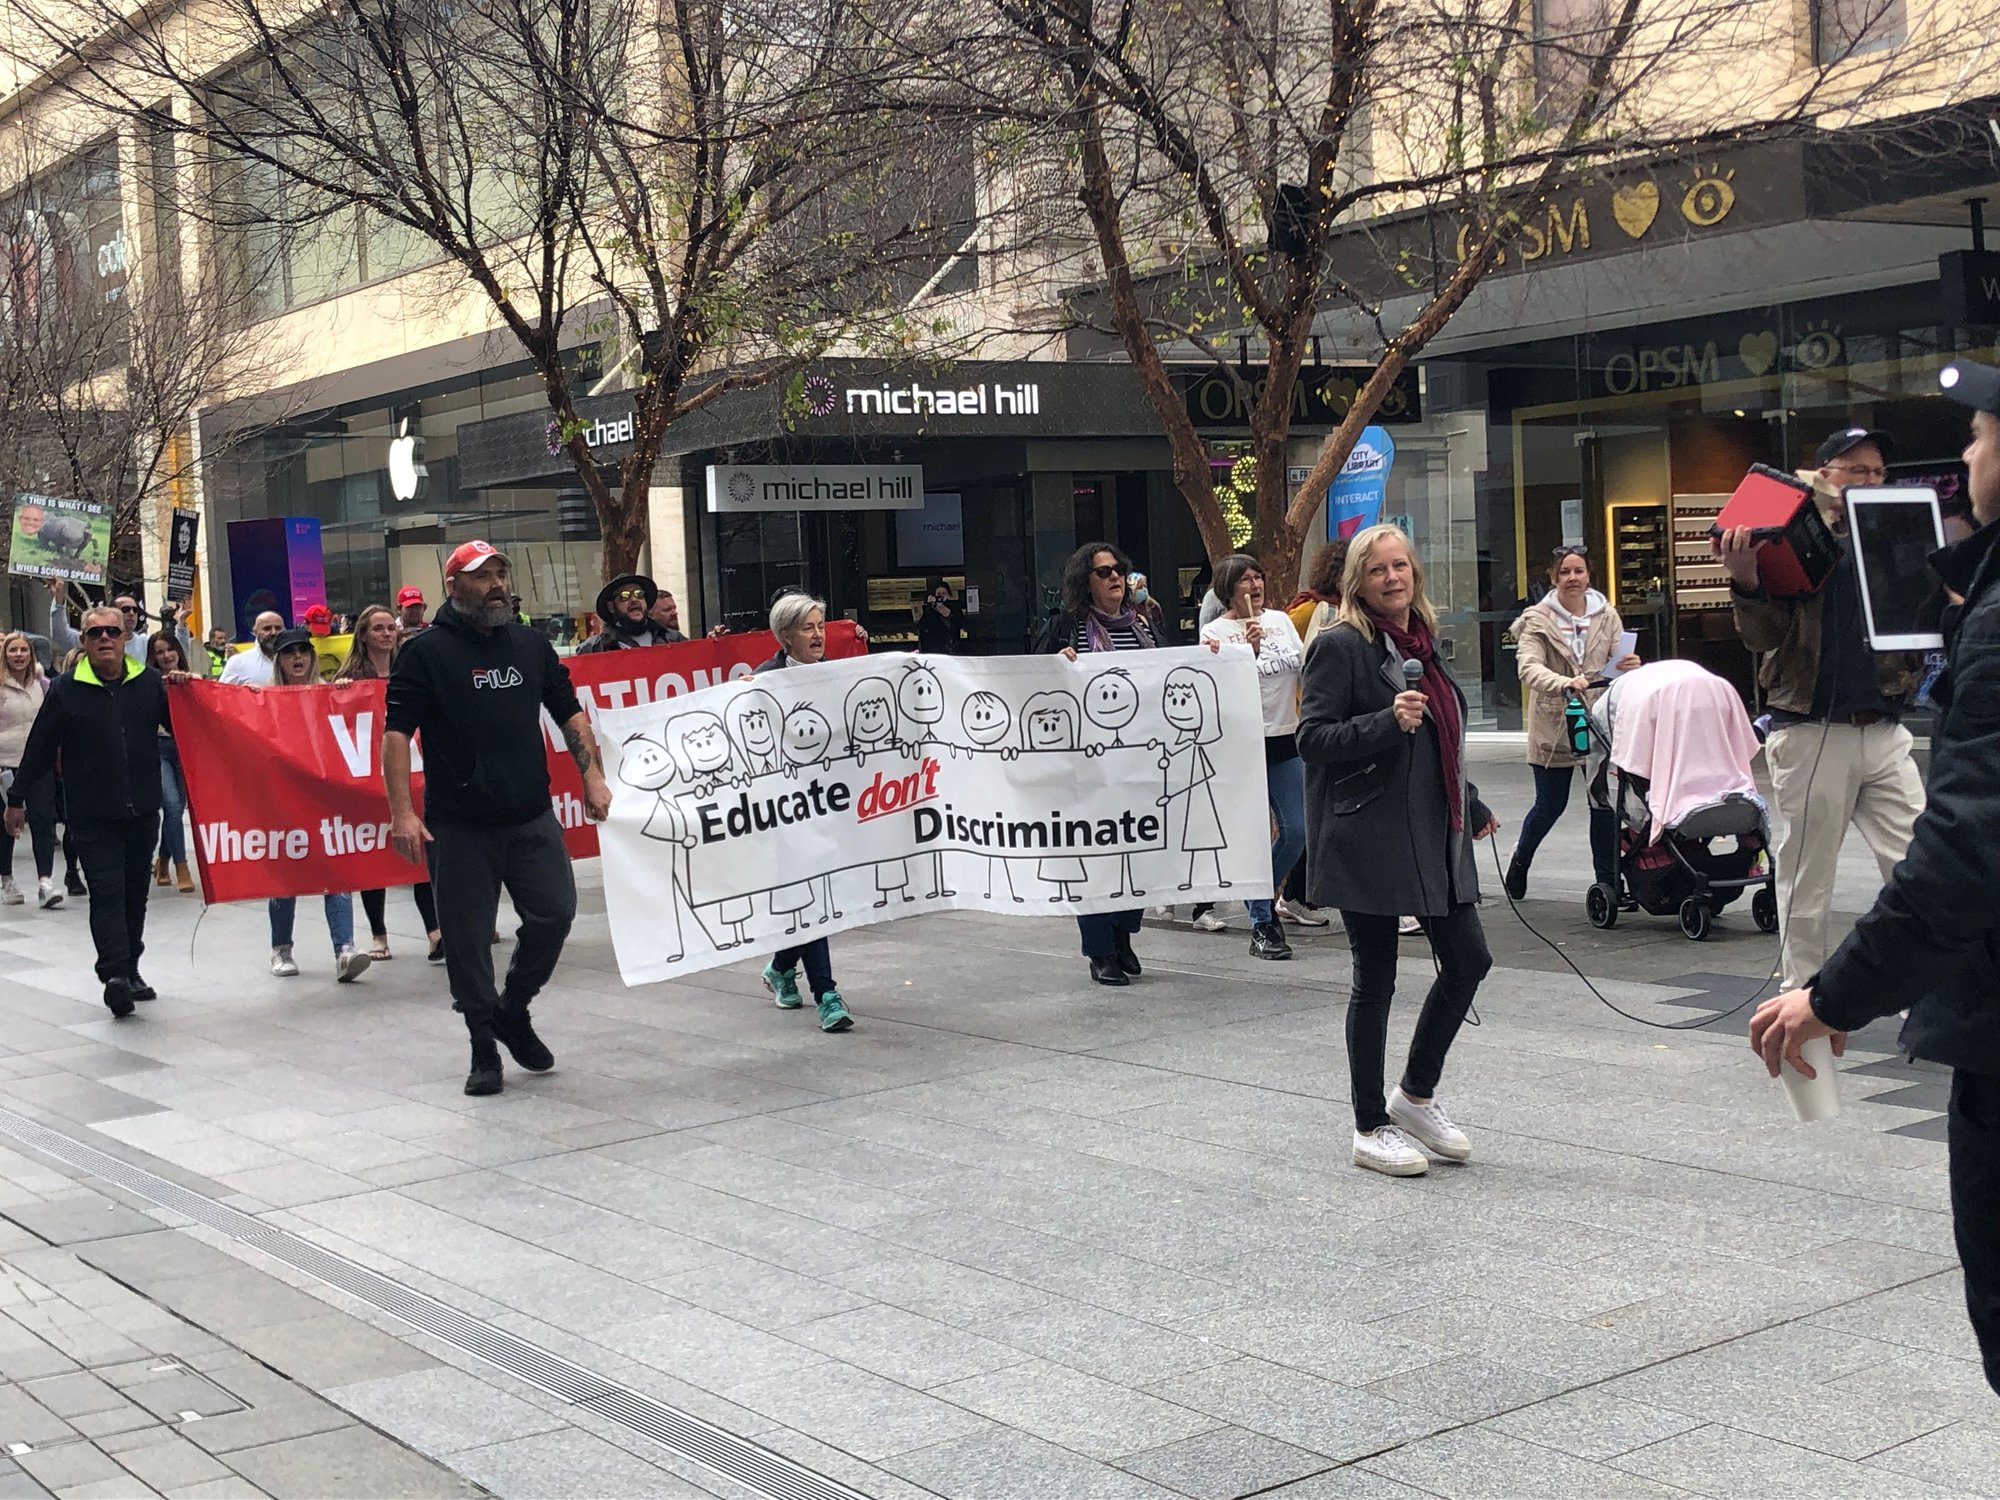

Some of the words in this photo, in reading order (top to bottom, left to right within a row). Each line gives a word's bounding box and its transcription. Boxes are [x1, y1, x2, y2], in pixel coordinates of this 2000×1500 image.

[1457, 197, 1590, 265] SM
[1605, 341, 1720, 394] OPSM
[846, 383, 986, 415] michael
[995, 384, 1039, 414] hill
[582, 411, 634, 447] chael
[1347, 458, 1380, 472] LIBRARY
[1352, 450, 1370, 461] CITY
[763, 477, 870, 500] michael
[879, 476, 913, 499] hill
[1335, 490, 1380, 505] INTERACT
[28, 496, 46, 506] THIS
[47, 498, 56, 508] IS
[57, 500, 81, 512] WHAT
[87, 504, 102, 514] SEE
[16, 562, 39, 575] WHEN
[70, 570, 101, 582] SPEAKS
[472, 666, 523, 689] FILA
[1257, 655, 1300, 676] ACCINE
[697, 779, 851, 845] Educate
[857, 757, 940, 822] don't
[320, 816, 392, 857] ther
[913, 805, 1160, 849] Discriminate
